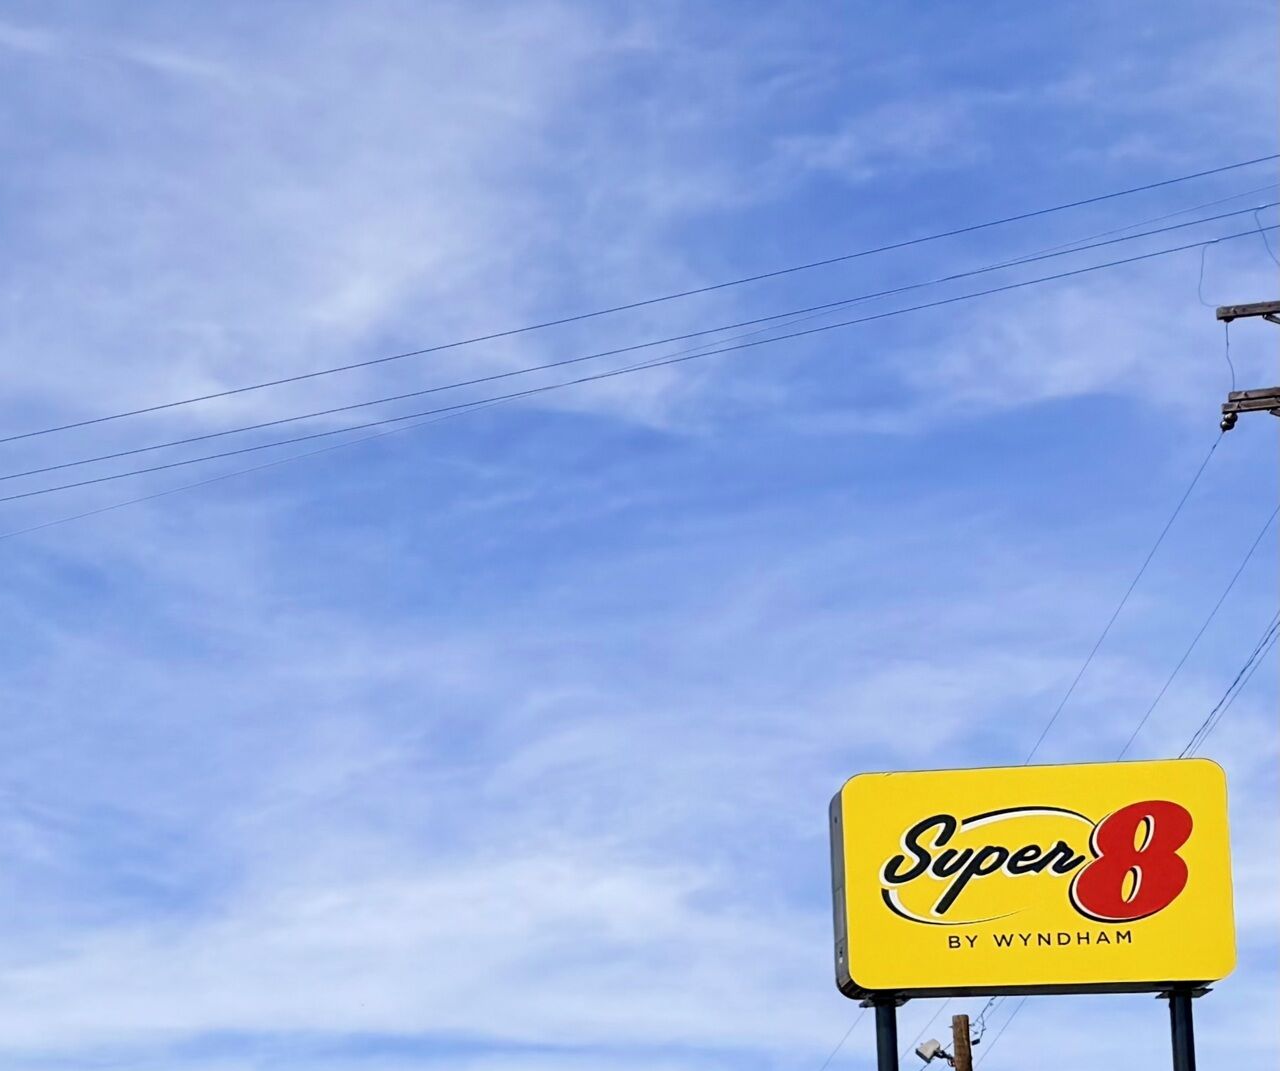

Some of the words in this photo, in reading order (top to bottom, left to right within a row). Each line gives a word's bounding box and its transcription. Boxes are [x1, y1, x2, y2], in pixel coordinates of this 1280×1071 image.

[883, 813, 1087, 915] Super
[1069, 799, 1194, 924] 8
[947, 934, 979, 950] BY
[992, 929, 1133, 948] WYNDHAM
